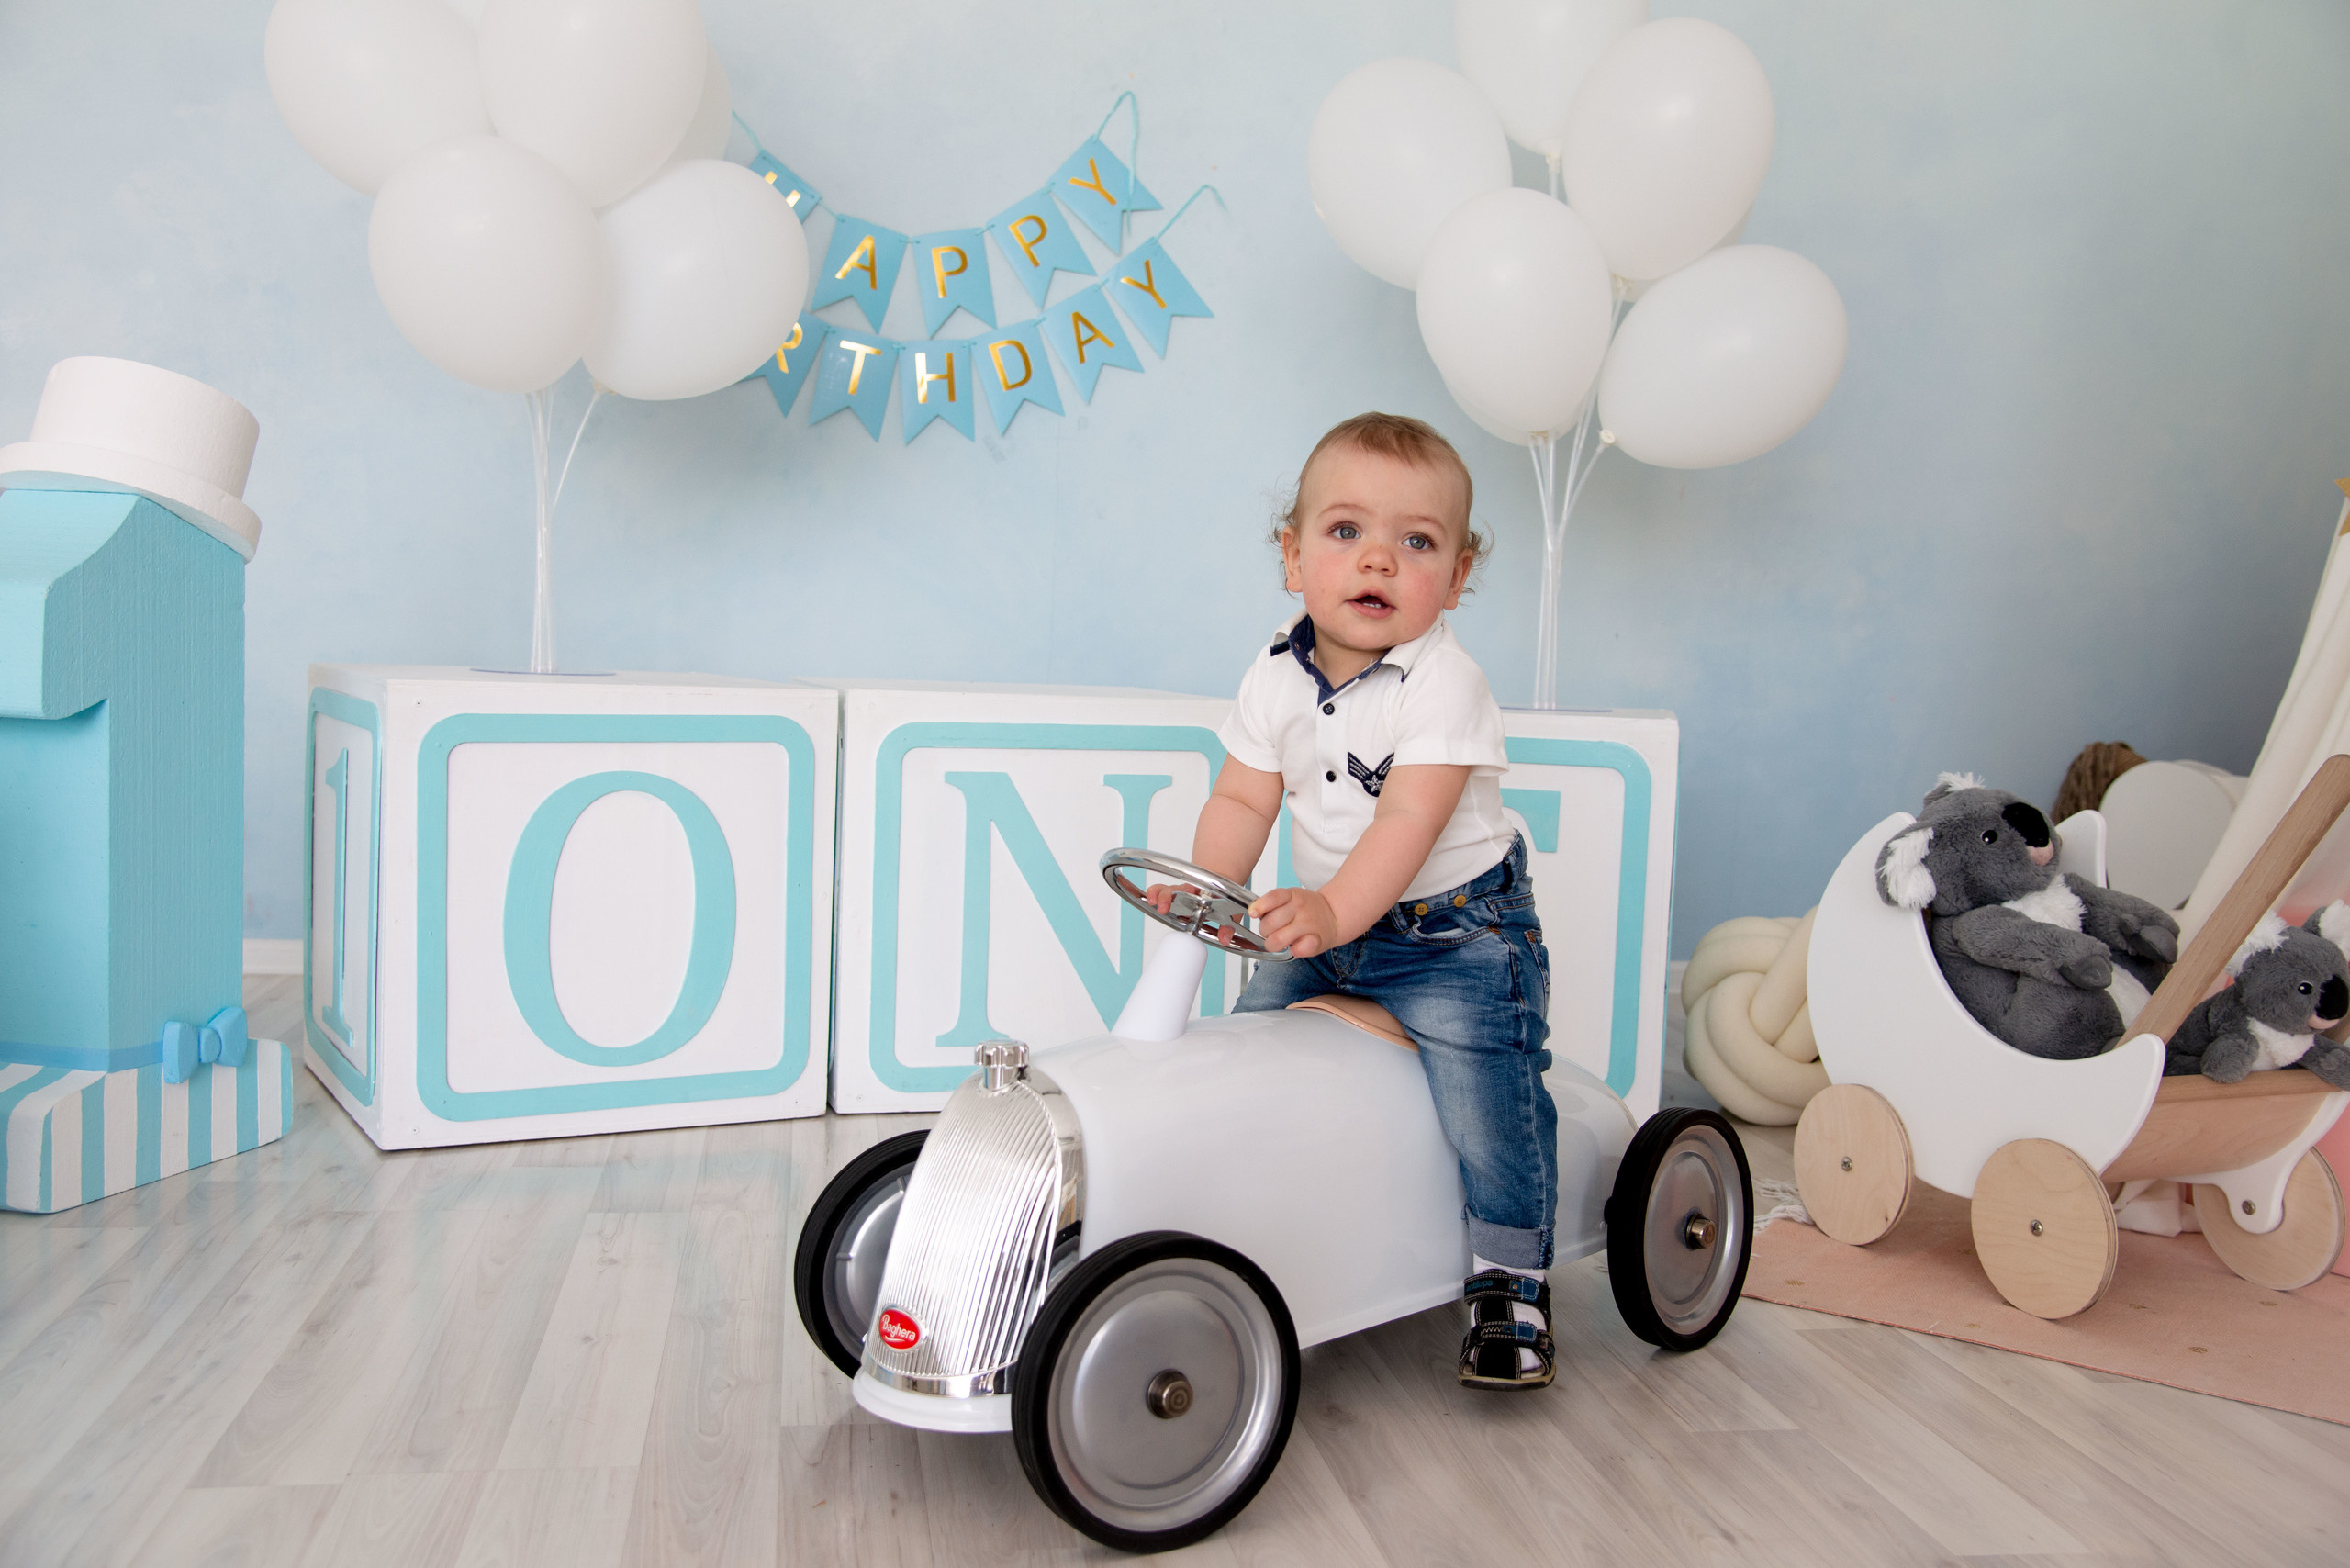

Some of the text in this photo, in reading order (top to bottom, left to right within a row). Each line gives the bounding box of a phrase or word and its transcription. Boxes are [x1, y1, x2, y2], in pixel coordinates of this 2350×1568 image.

[774, 259, 1167, 404] RTHDAY
[321, 747, 354, 1048] 1
[502, 769, 1561, 1068] ON
[881, 1314, 916, 1341] Baghera
